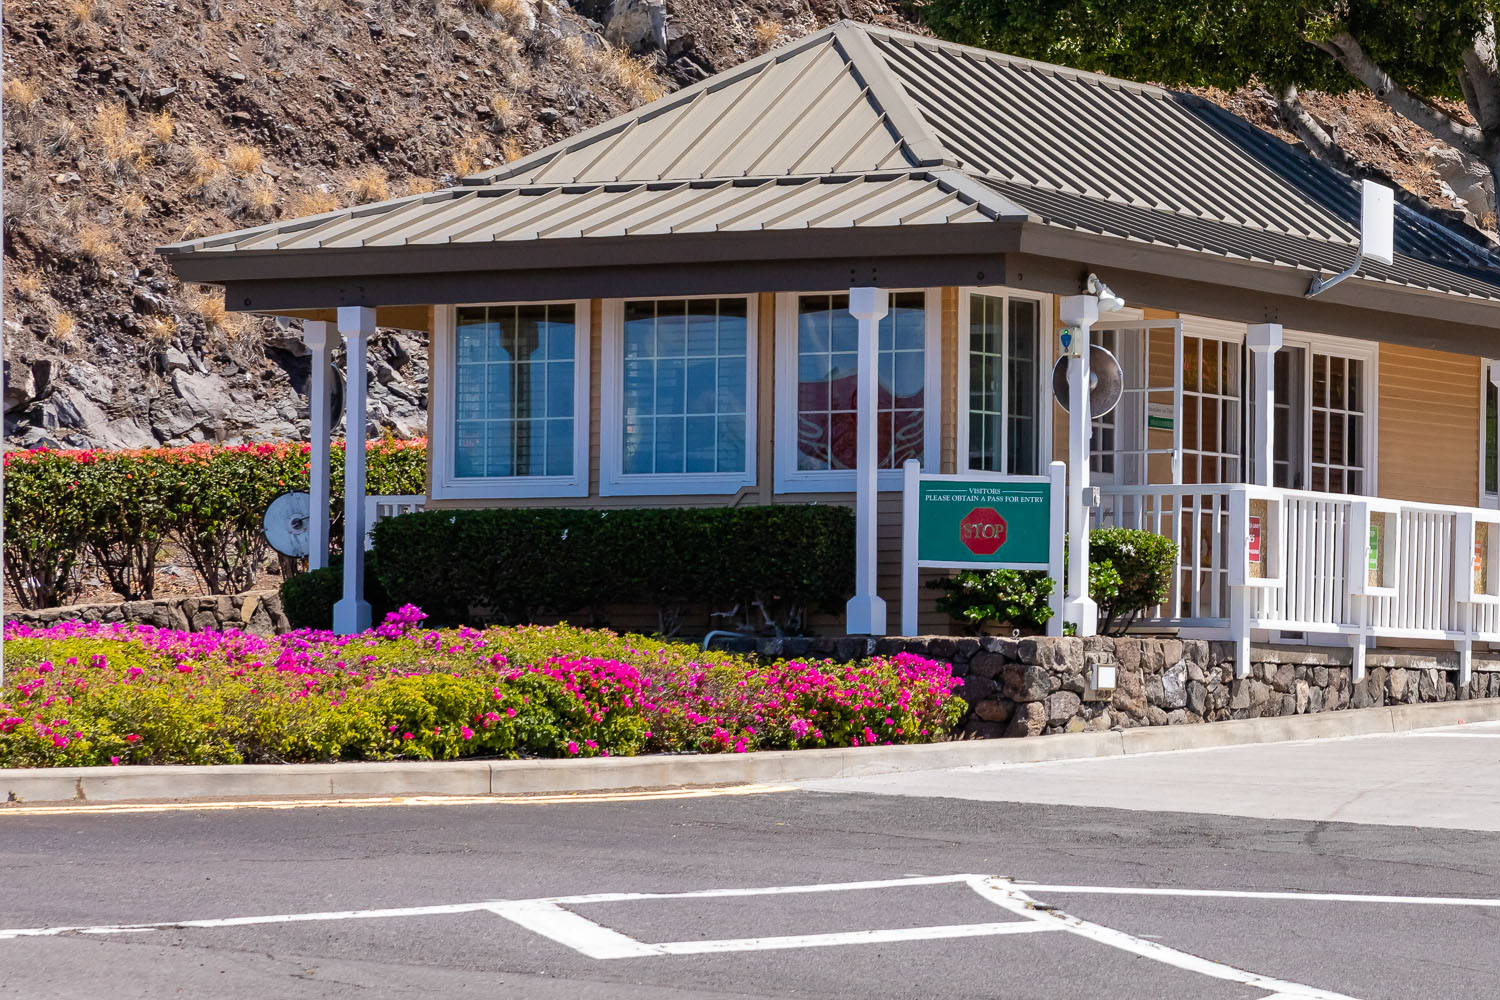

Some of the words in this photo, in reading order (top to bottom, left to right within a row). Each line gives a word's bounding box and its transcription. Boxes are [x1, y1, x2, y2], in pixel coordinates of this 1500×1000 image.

[968, 487, 1001, 495] VISITORS
[925, 494, 950, 502] PLEASE
[951, 494, 979, 502] OBTAIN
[1020, 496, 1044, 504] ENTRY
[963, 522, 1004, 539] STOP
